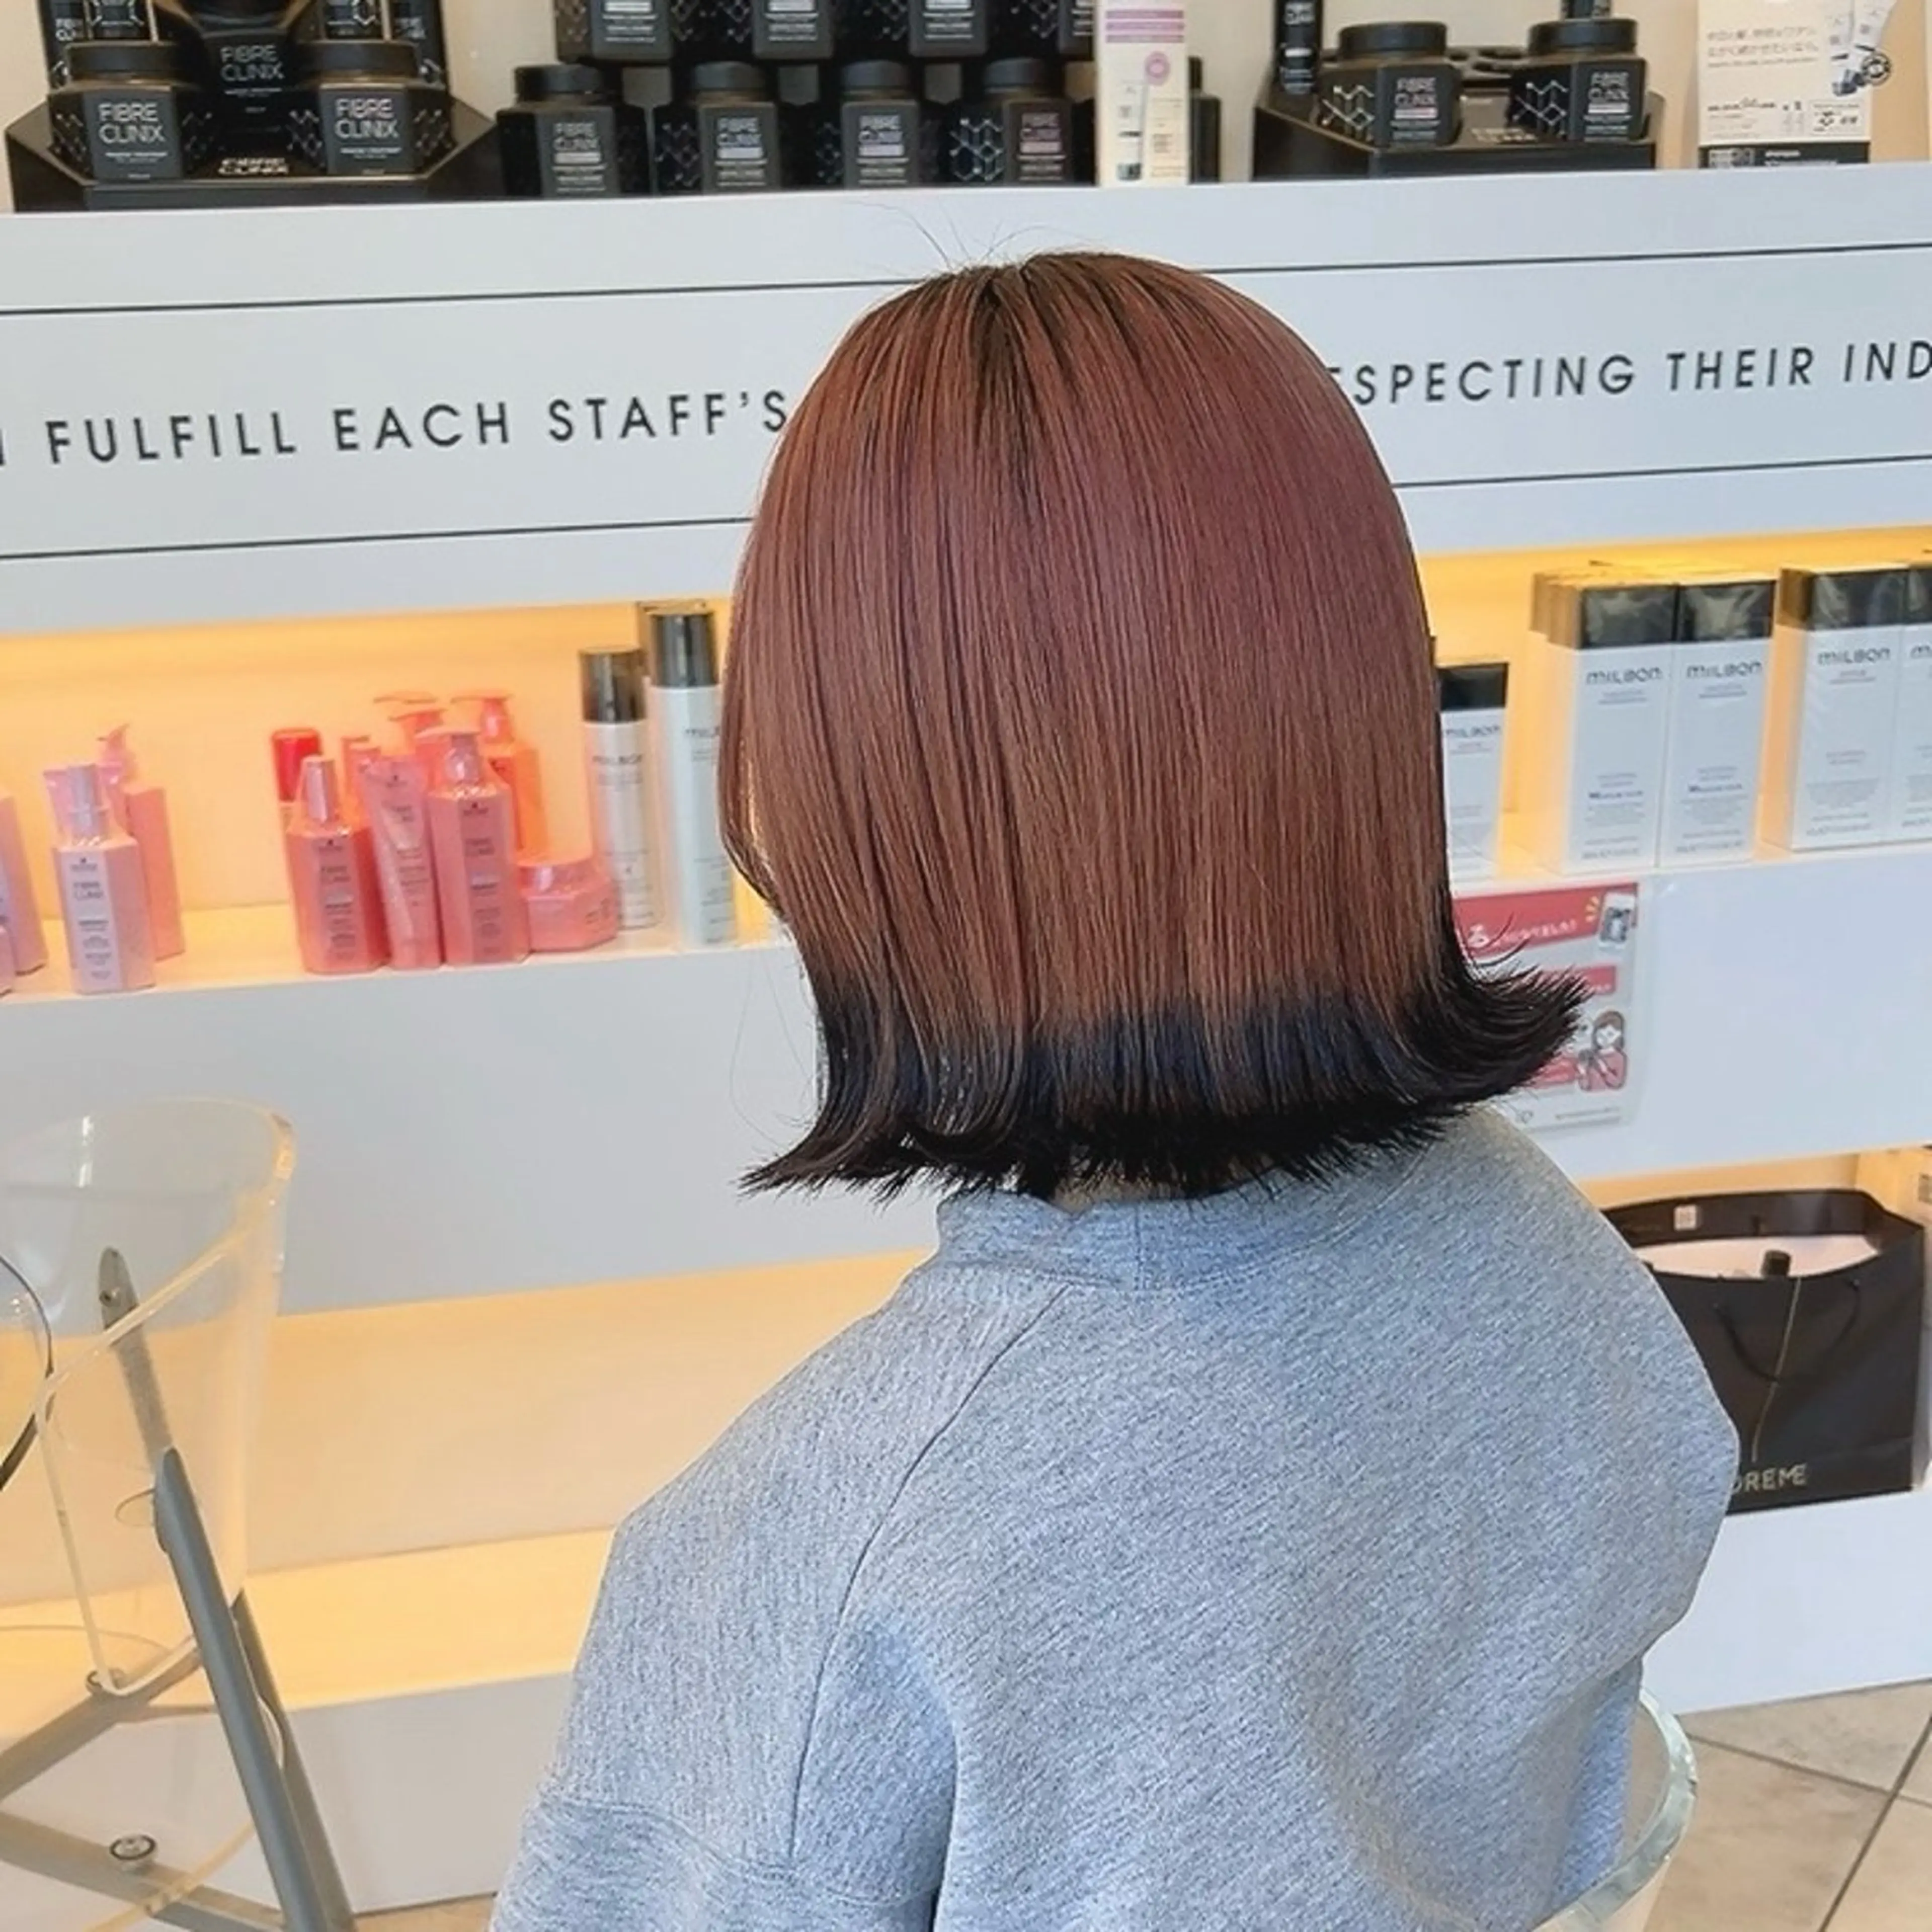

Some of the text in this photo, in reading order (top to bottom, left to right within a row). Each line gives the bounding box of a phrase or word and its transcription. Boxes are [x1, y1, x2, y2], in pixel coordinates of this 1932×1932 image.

[99, 103, 158, 122] FIBRE
[335, 98, 393, 119] FIBRE
[98, 124, 166, 144] CLINIX
[45, 411, 297, 464] FULFILL
[332, 401, 509, 451] EACH
[546, 390, 788, 443] STAFF'S
[1327, 354, 1635, 405] SPECTING
[1666, 346, 1815, 391] THEIR
[1843, 340, 1932, 383] IND
